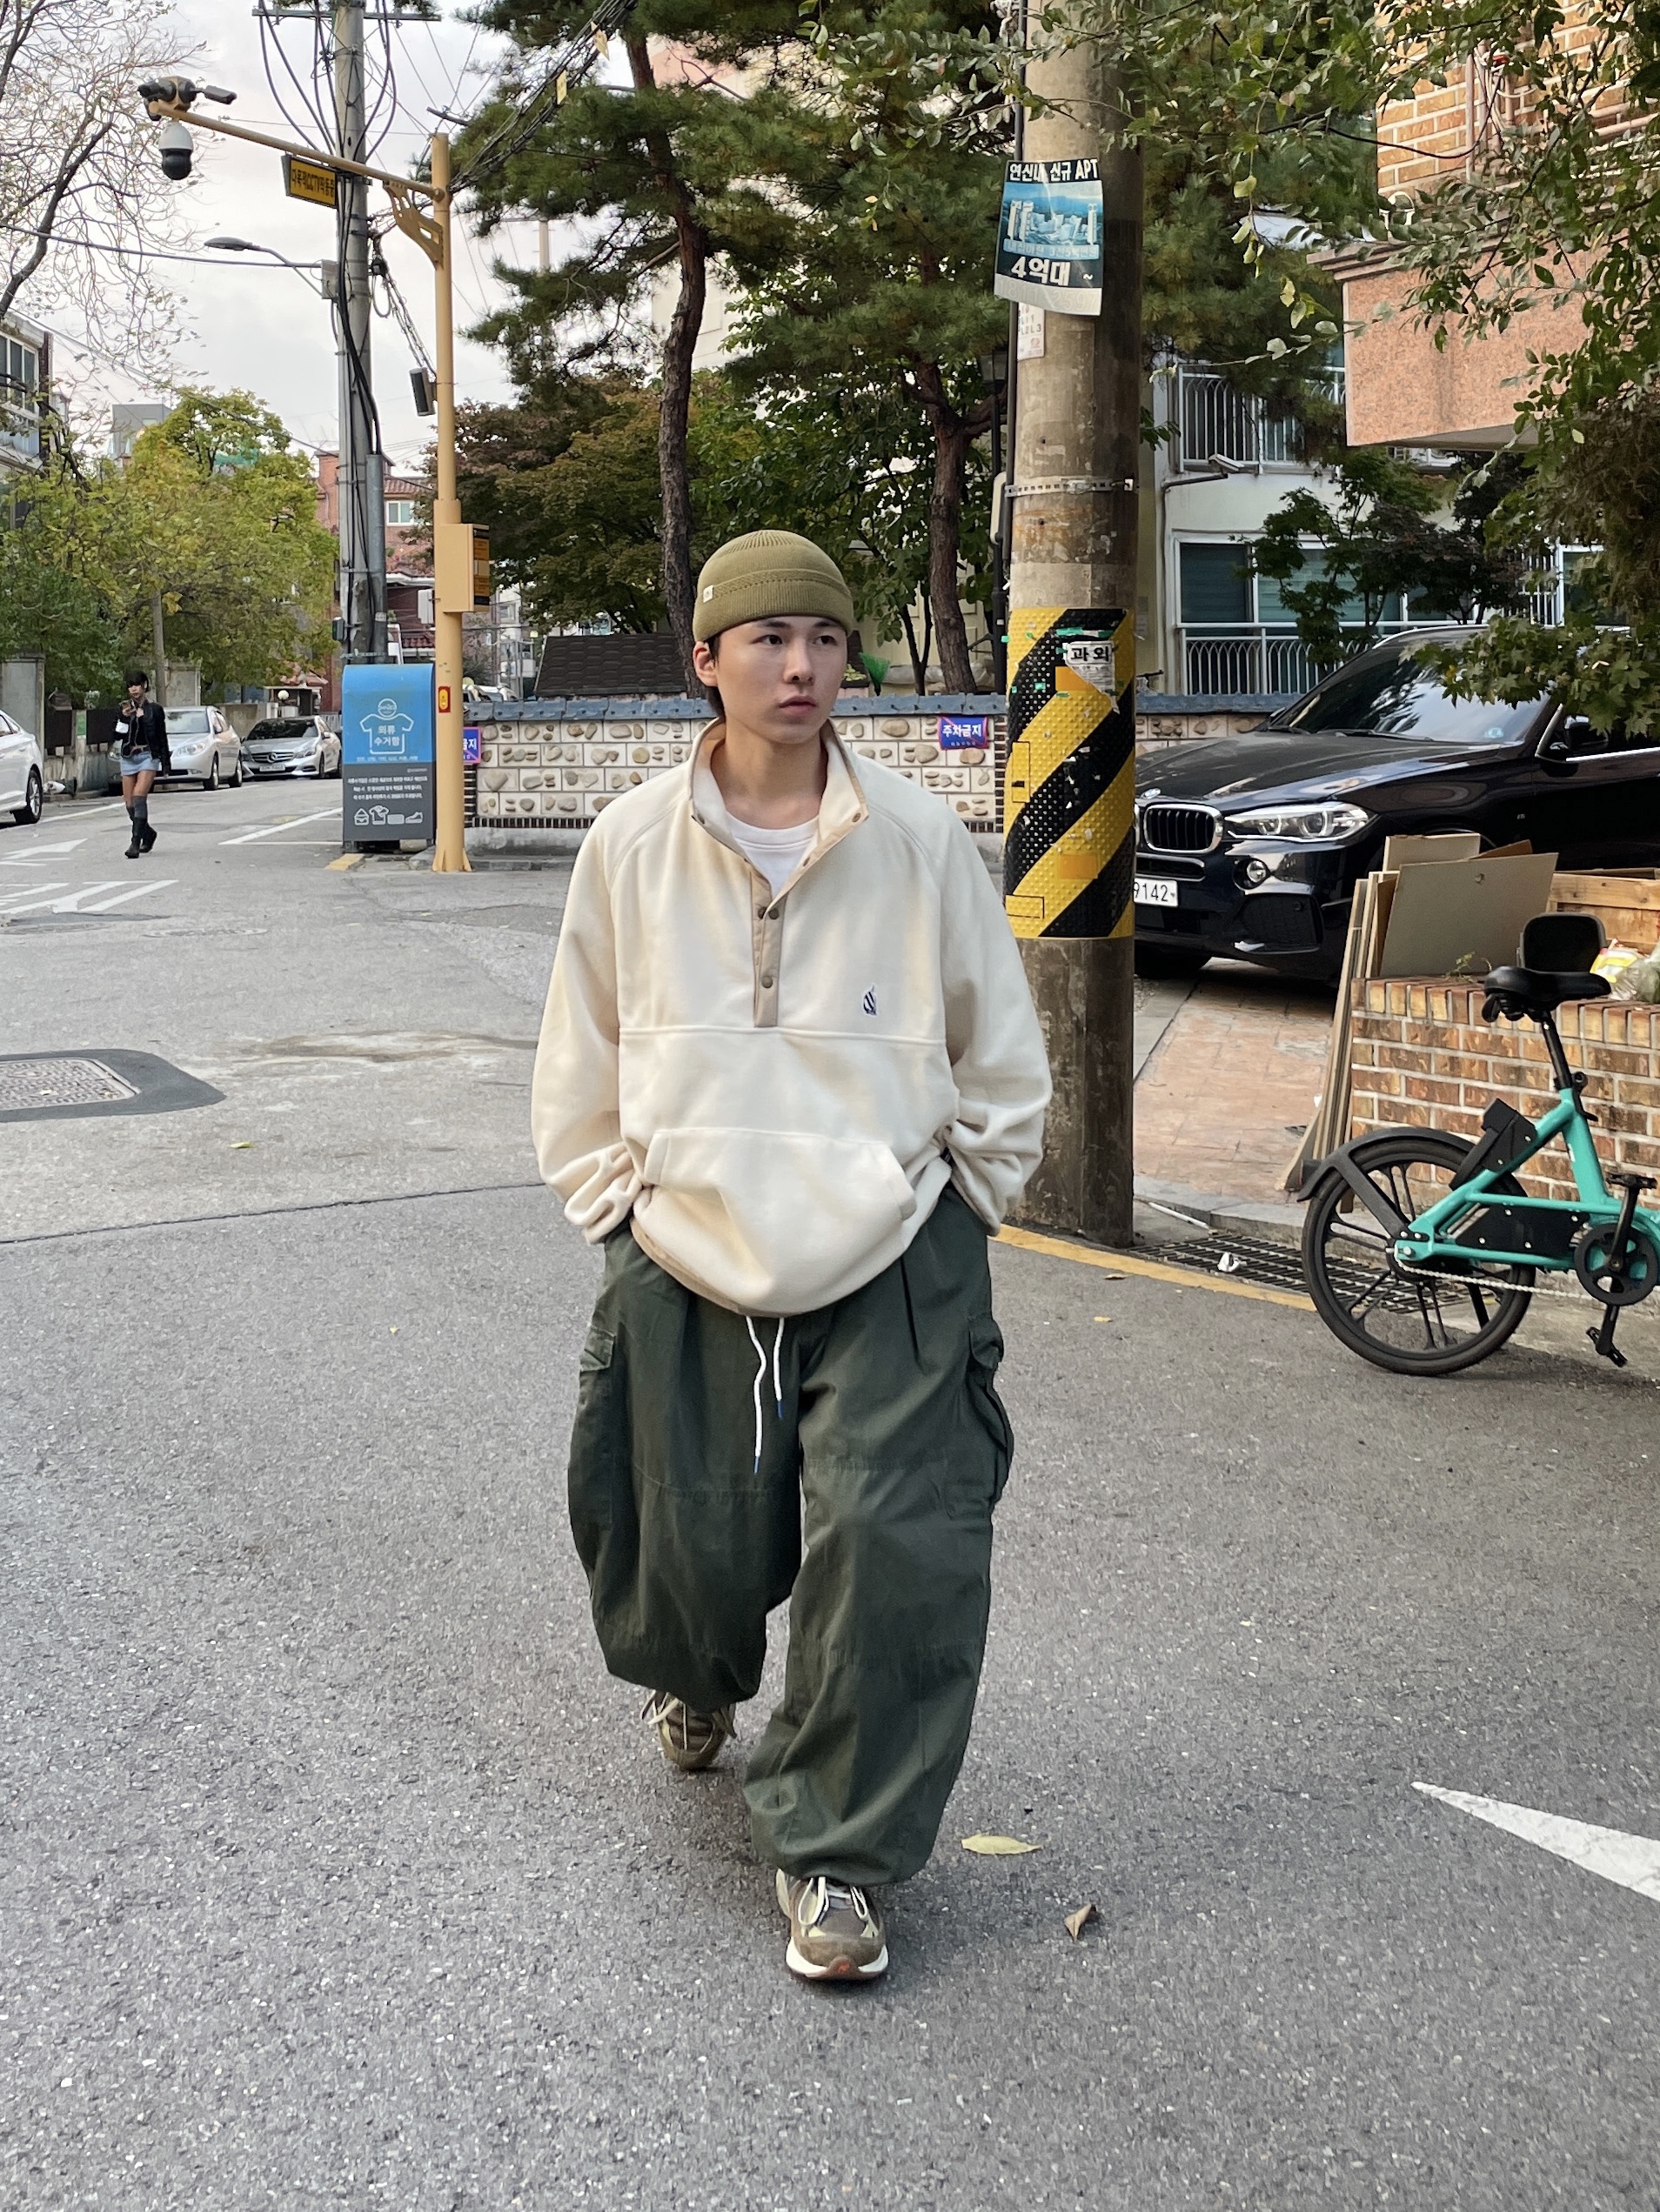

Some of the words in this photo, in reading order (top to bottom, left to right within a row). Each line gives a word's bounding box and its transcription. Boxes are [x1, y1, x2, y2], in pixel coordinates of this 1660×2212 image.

[1050, 161, 1072, 182] 신규
[1074, 158, 1098, 180] APT
[1010, 256, 1071, 286] 4억대
[378, 725, 396, 735] 의류
[942, 724, 982, 738] 주차금지
[373, 736, 400, 746] 수거함
